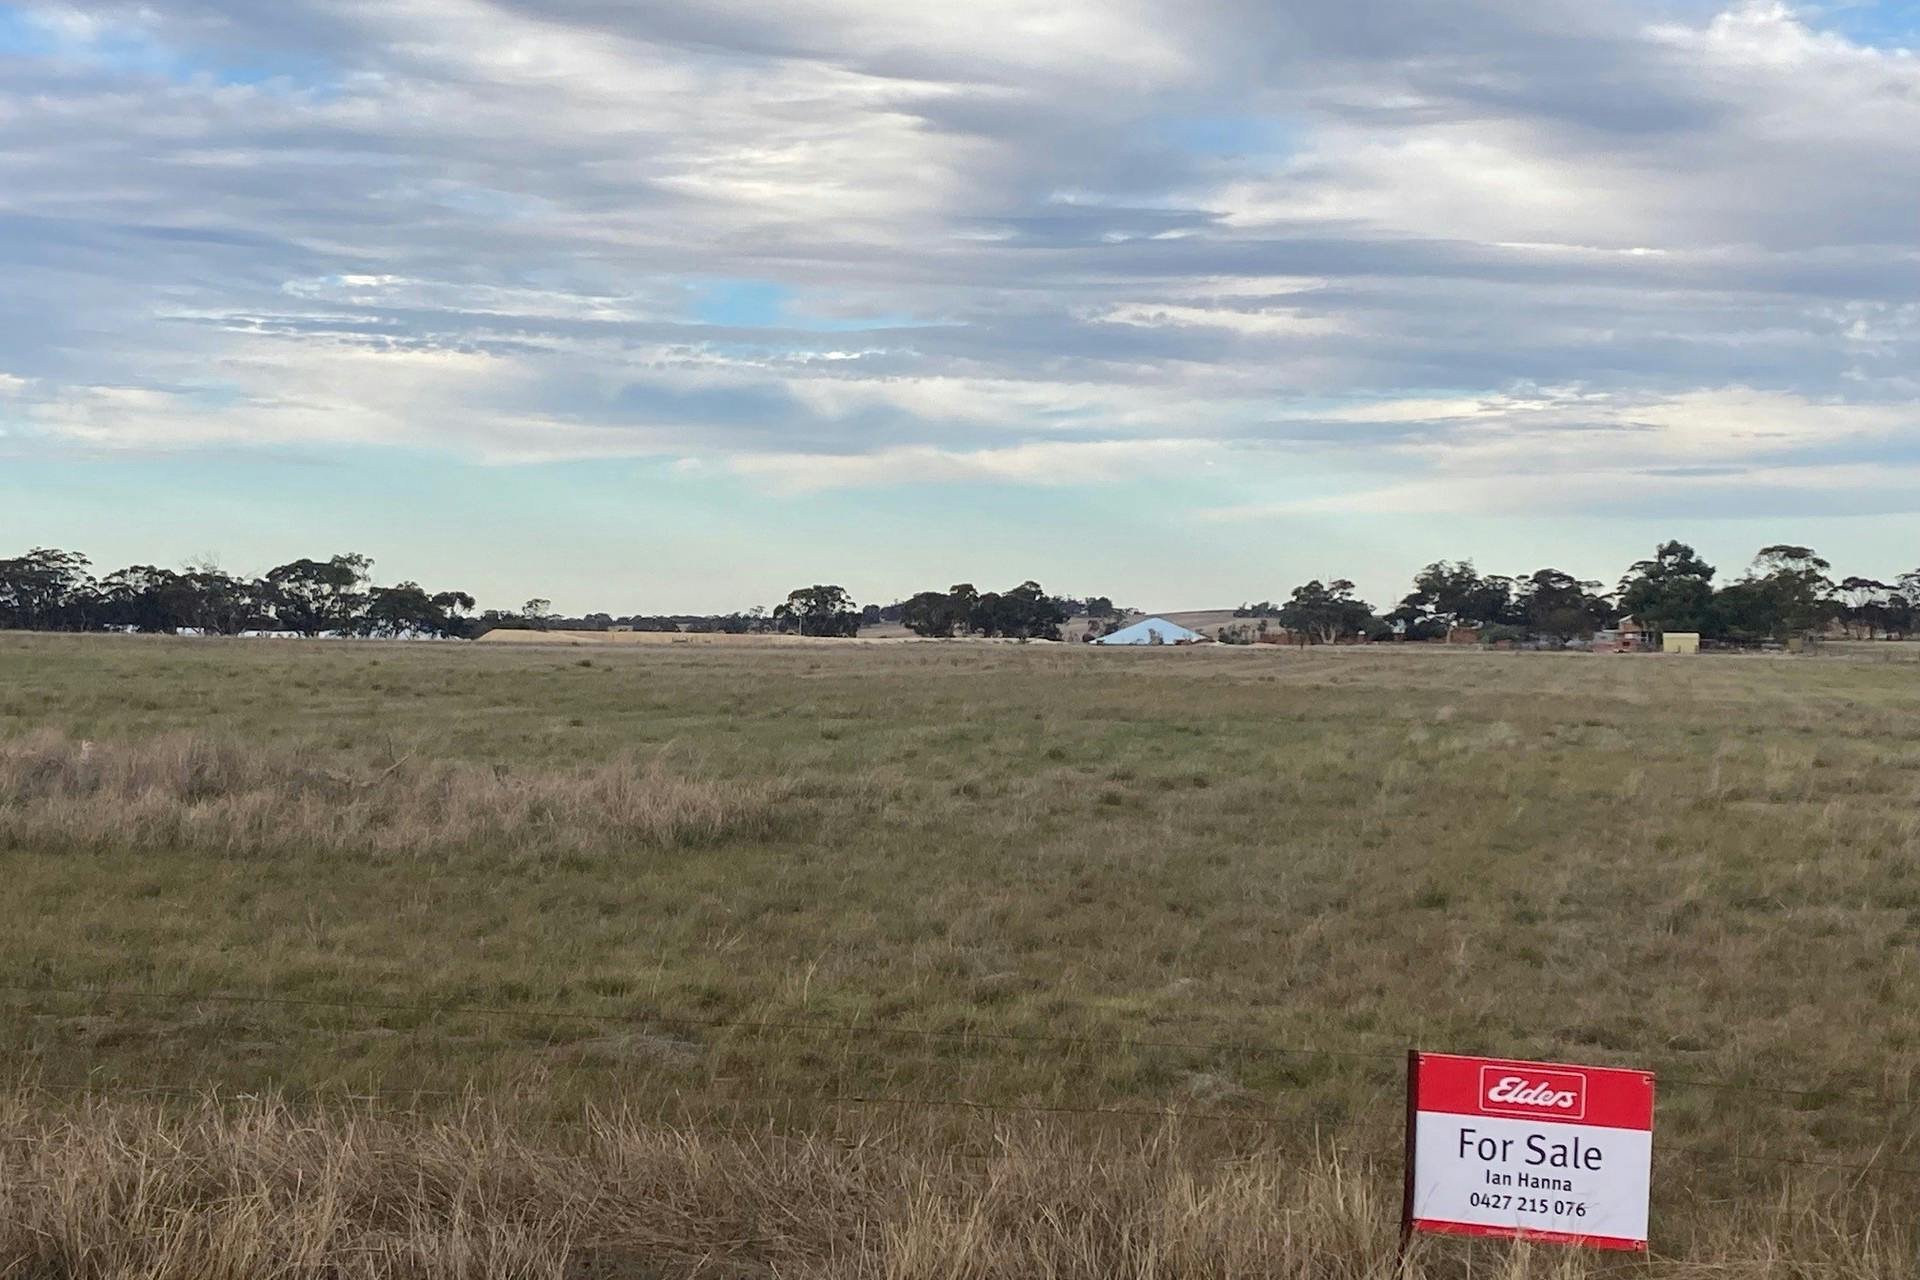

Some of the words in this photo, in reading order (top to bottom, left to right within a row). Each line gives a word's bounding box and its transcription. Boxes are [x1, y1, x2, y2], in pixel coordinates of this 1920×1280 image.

[1488, 1076, 1578, 1109] Elders
[1459, 1128, 1514, 1162] For
[1524, 1134, 1603, 1170] Sale
[1486, 1170, 1512, 1186] Ian
[1518, 1173, 1572, 1192] Hanna
[1470, 1193, 1512, 1210] 0427
[1517, 1197, 1548, 1213] 215
[1554, 1200, 1586, 1217] 076
